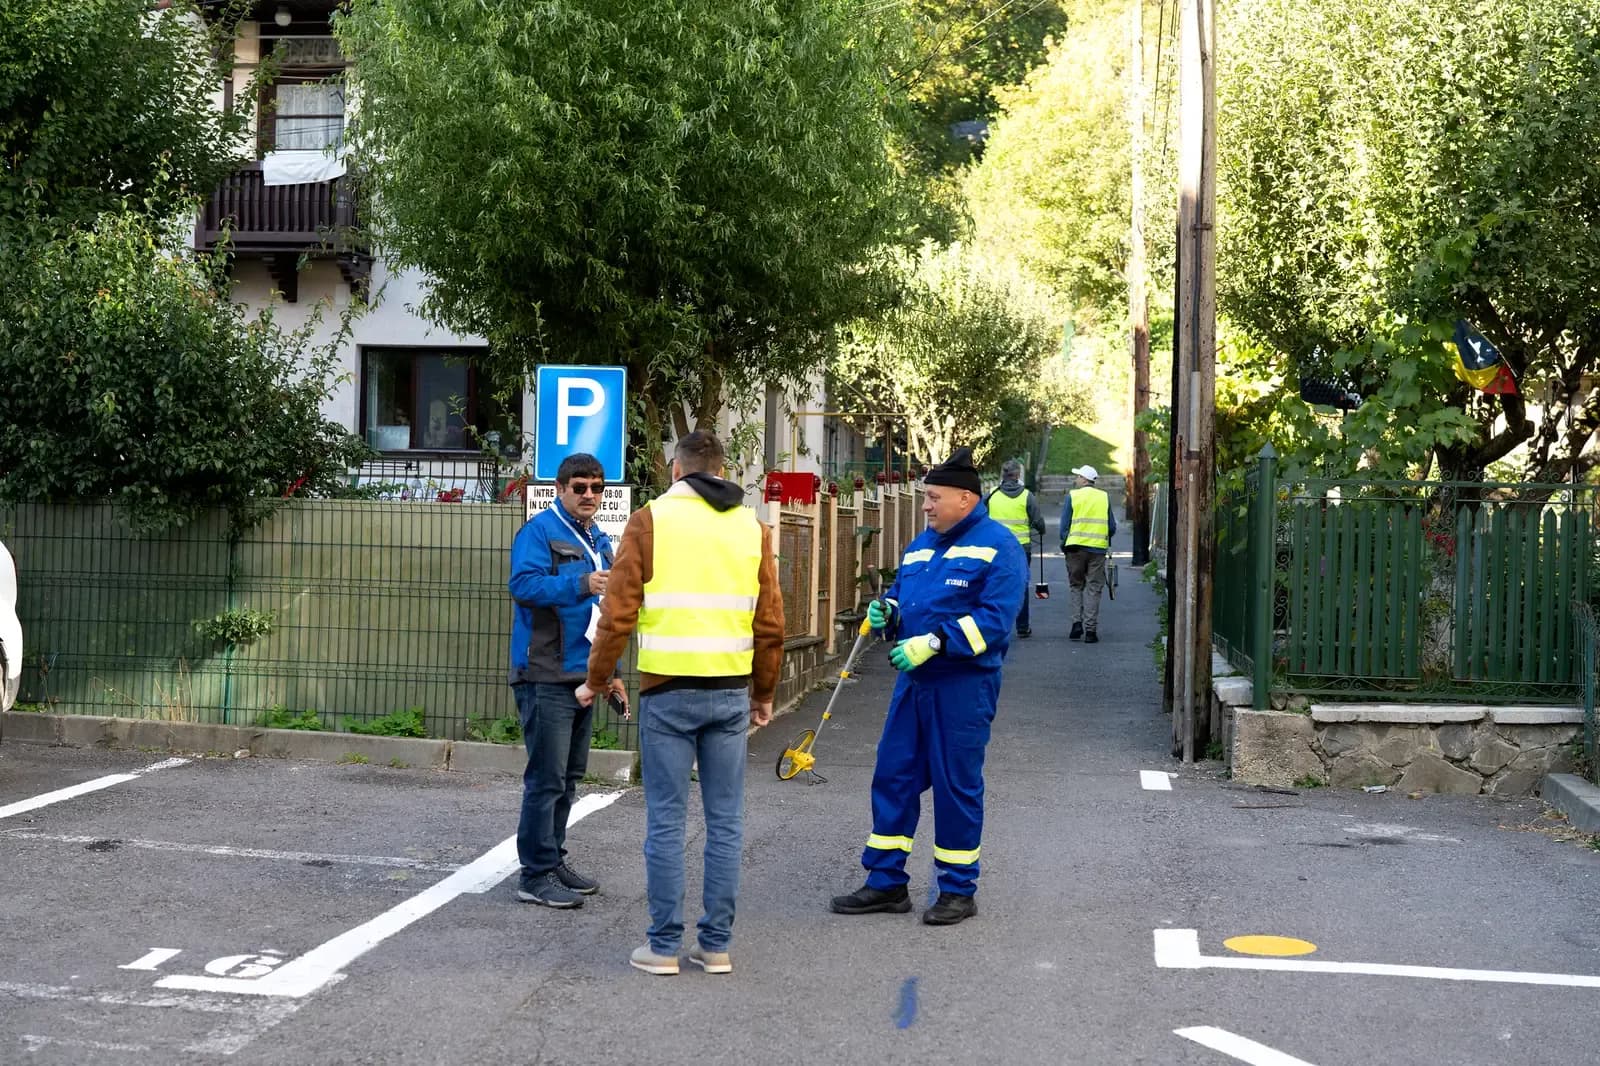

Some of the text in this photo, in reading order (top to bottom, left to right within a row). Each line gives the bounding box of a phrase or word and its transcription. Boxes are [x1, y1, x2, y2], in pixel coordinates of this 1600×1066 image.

[556, 376, 605, 446] P
[533, 486, 623, 499] ÎNTRE 08:00
[529, 499, 537, 510] ÎN
[608, 501, 619, 511] CU
[593, 513, 628, 522] HICULELOR
